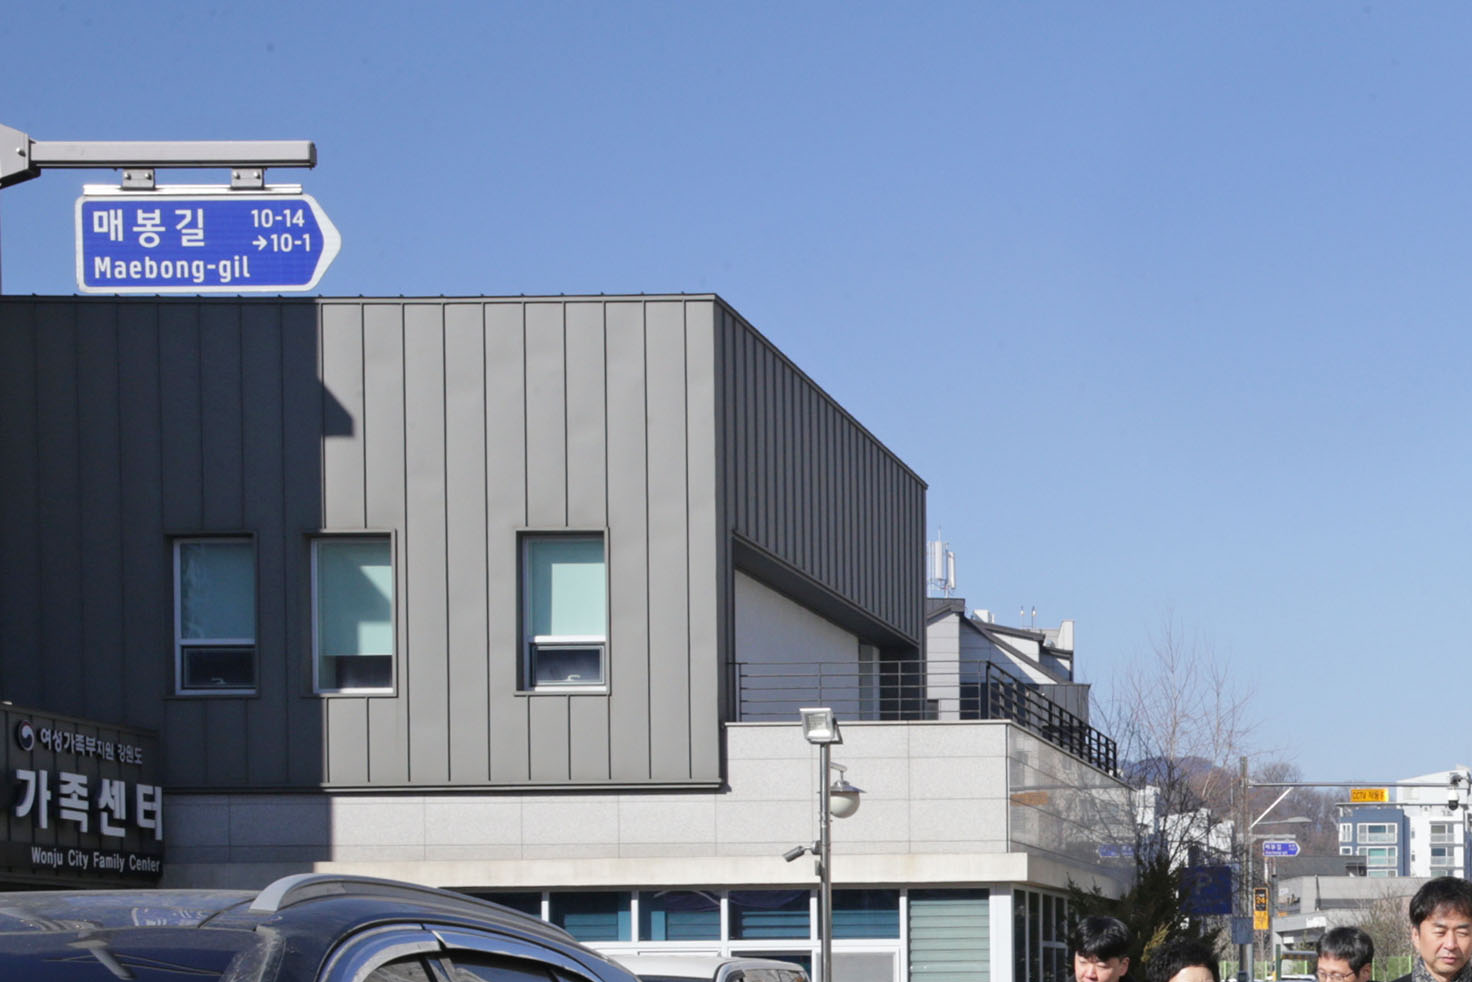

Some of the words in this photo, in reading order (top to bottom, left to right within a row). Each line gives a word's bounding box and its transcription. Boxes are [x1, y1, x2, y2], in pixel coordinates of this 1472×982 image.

[93, 208, 205, 248] 매봉길
[251, 209, 305, 228] 10-14
[94, 255, 250, 283] Maebong-gil
[117, 743, 143, 764] 강원도
[15, 769, 163, 840] 가족센터
[31, 846, 63, 868] Wonju
[68, 849, 88, 870] City
[93, 851, 125, 872] Family
[129, 854, 160, 872] Center
